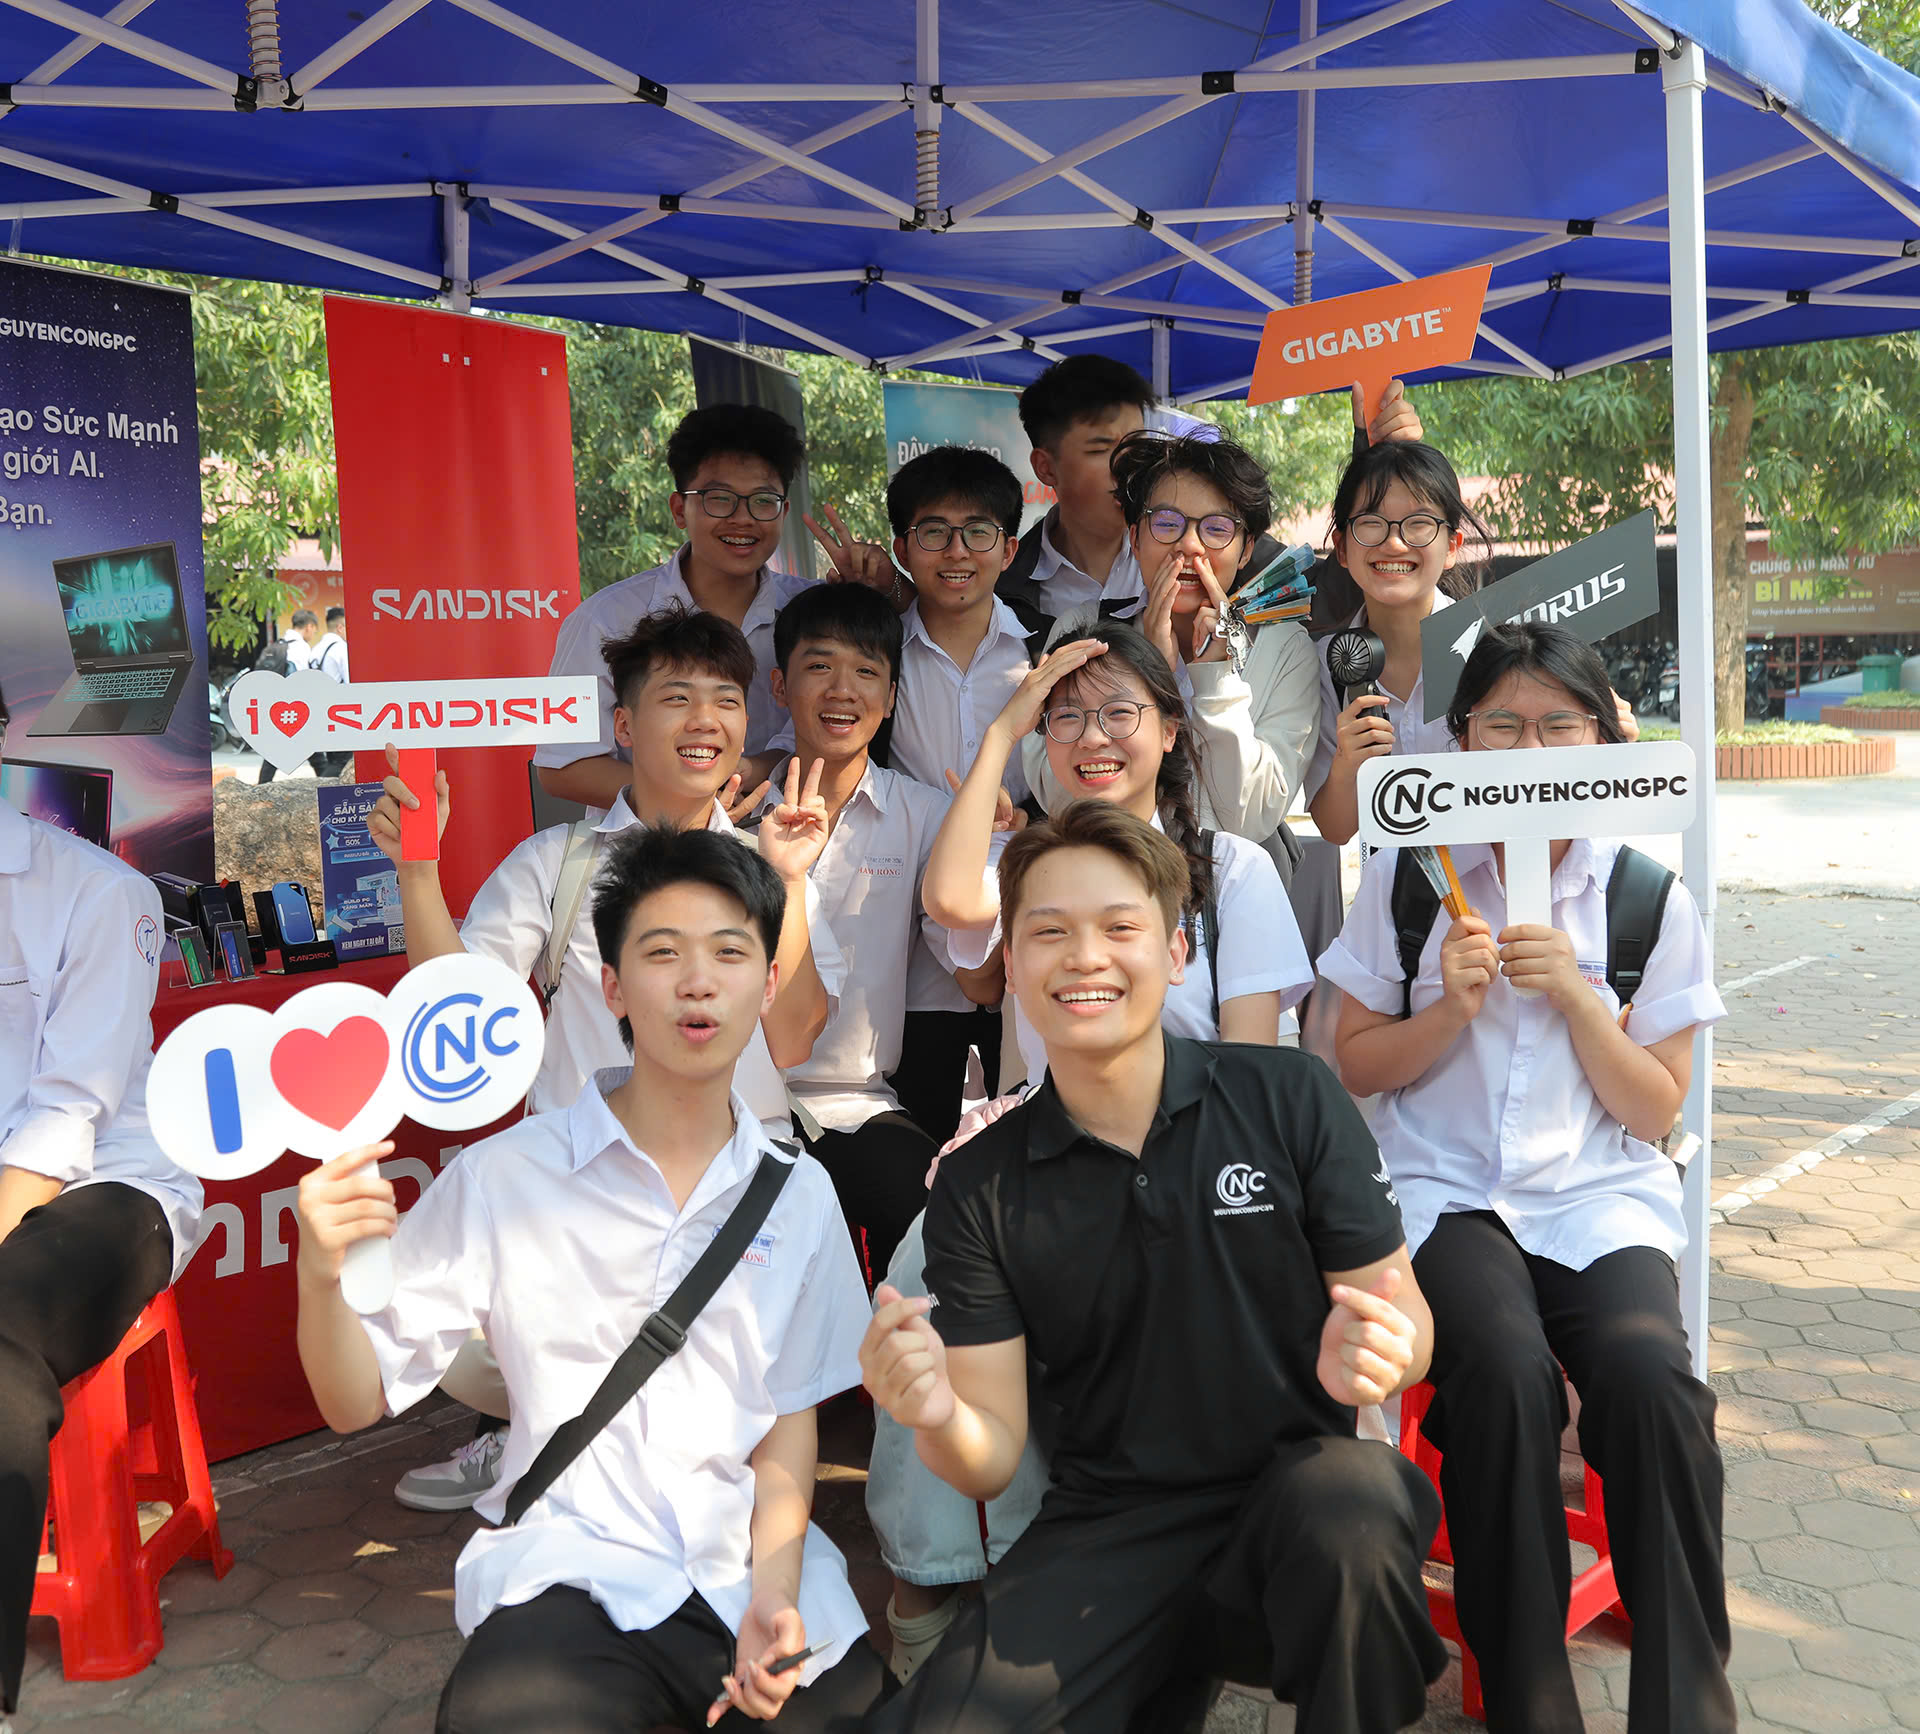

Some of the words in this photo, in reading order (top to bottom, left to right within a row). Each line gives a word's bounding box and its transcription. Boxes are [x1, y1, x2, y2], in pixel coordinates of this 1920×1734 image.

[43, 405, 99, 437] Sức
[107, 412, 178, 447] Mạnh
[3, 446, 60, 480] giới
[69, 450, 104, 479] AI.
[1464, 775, 1688, 807] NGUYENCONGPC
[204, 1048, 243, 1154] I
